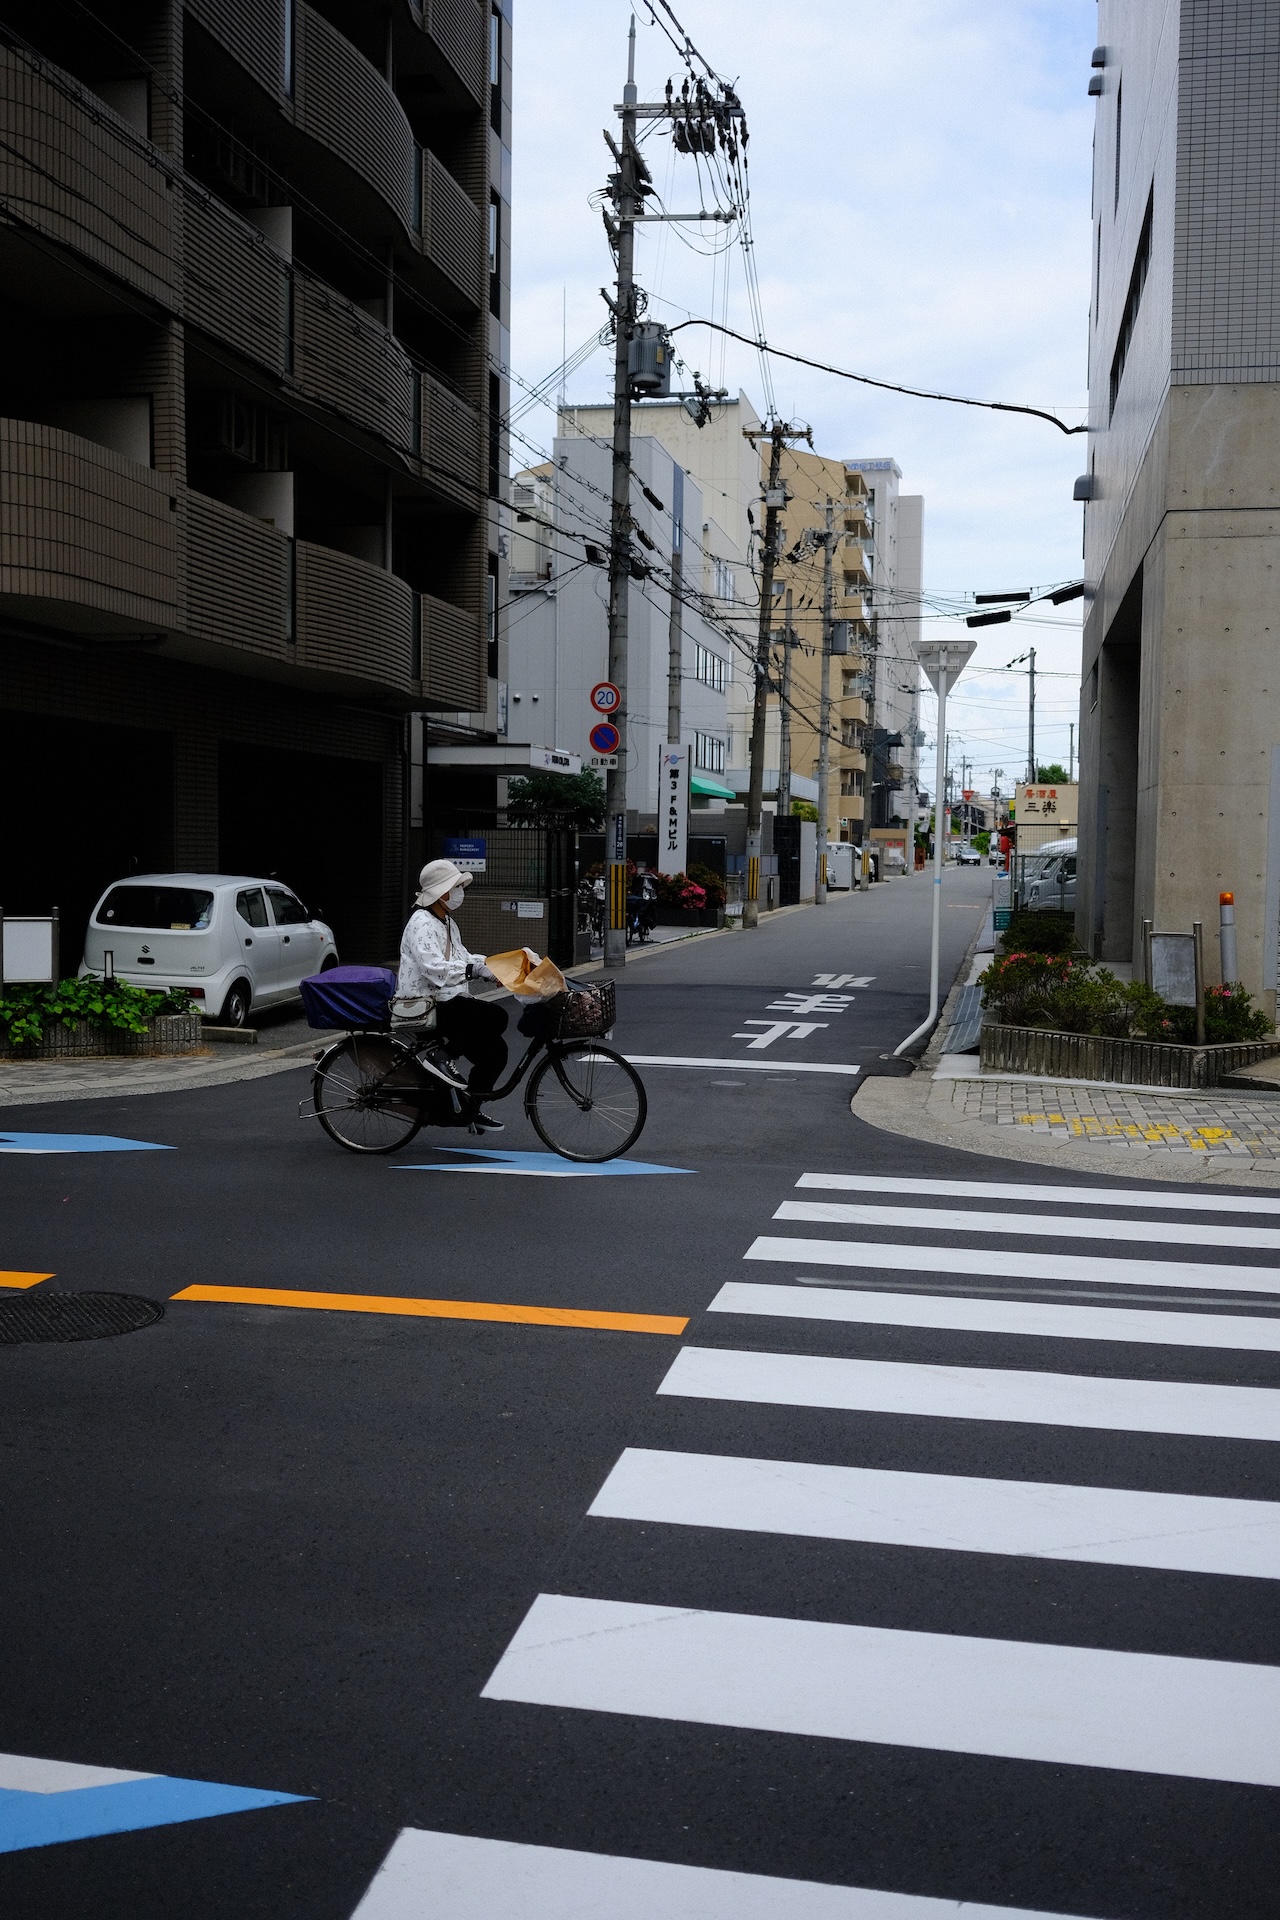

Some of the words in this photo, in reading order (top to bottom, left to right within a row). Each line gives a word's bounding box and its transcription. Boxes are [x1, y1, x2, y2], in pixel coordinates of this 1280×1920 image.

[597, 690, 614, 705] 20
[591, 757, 617, 766] 自動車
[1024, 789, 1058, 799] 居酒屋
[1024, 800, 1057, 813] 三楽
